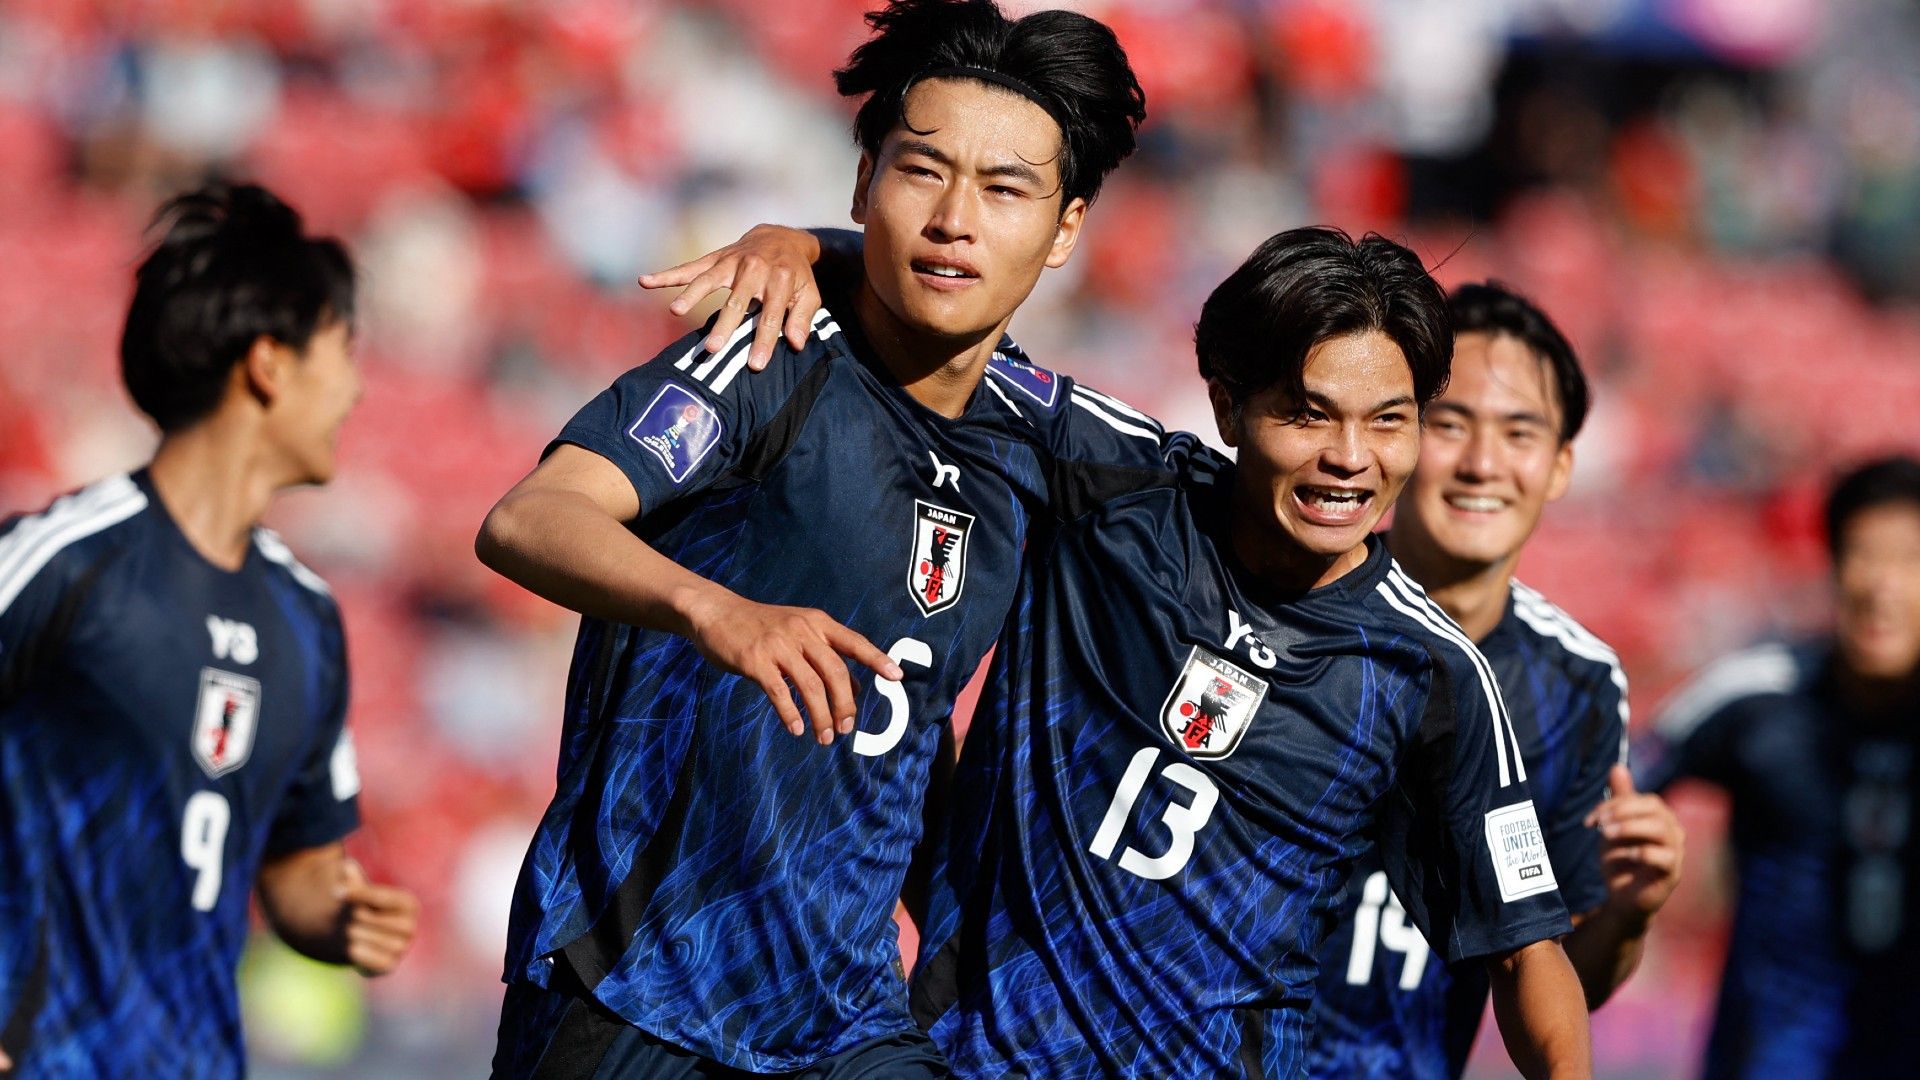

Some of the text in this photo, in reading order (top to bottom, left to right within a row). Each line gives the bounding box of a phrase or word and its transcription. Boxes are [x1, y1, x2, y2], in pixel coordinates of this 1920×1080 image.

[927, 508, 957, 525] JAPAN
[920, 577, 944, 600] JFA
[1209, 658, 1249, 685] JAPAN
[1177, 721, 1212, 748] JFA
[1088, 746, 1220, 880] 13
[182, 790, 230, 911] 9
[1502, 828, 1543, 853] UNITES
[1520, 866, 1541, 879] FIFA
